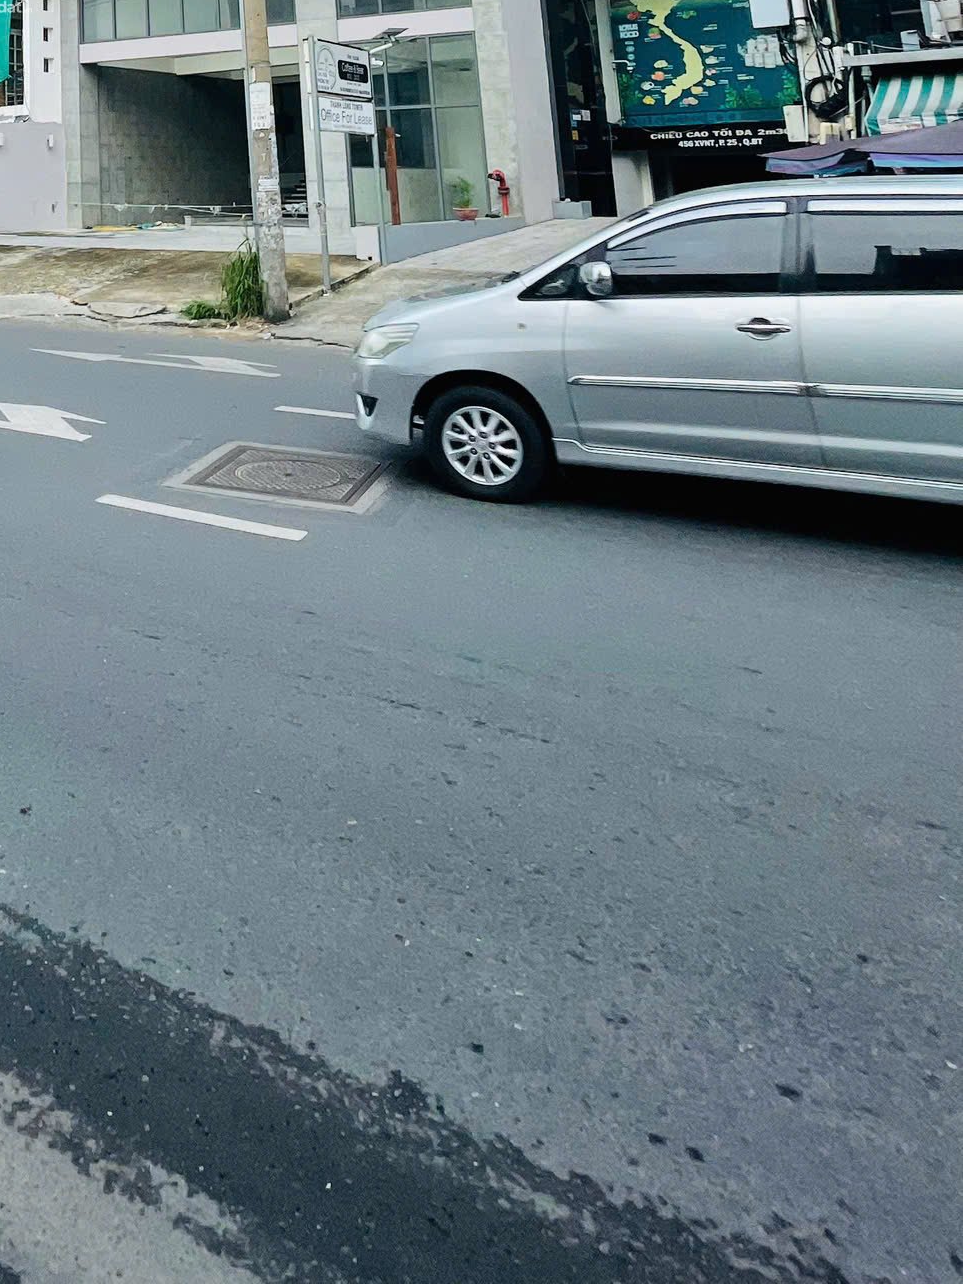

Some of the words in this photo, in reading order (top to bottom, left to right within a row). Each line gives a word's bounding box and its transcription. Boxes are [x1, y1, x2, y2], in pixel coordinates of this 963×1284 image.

[321, 108, 340, 123] Office
[342, 111, 353, 124] For
[354, 113, 373, 125] Lease
[712, 127, 732, 137] TỐI
